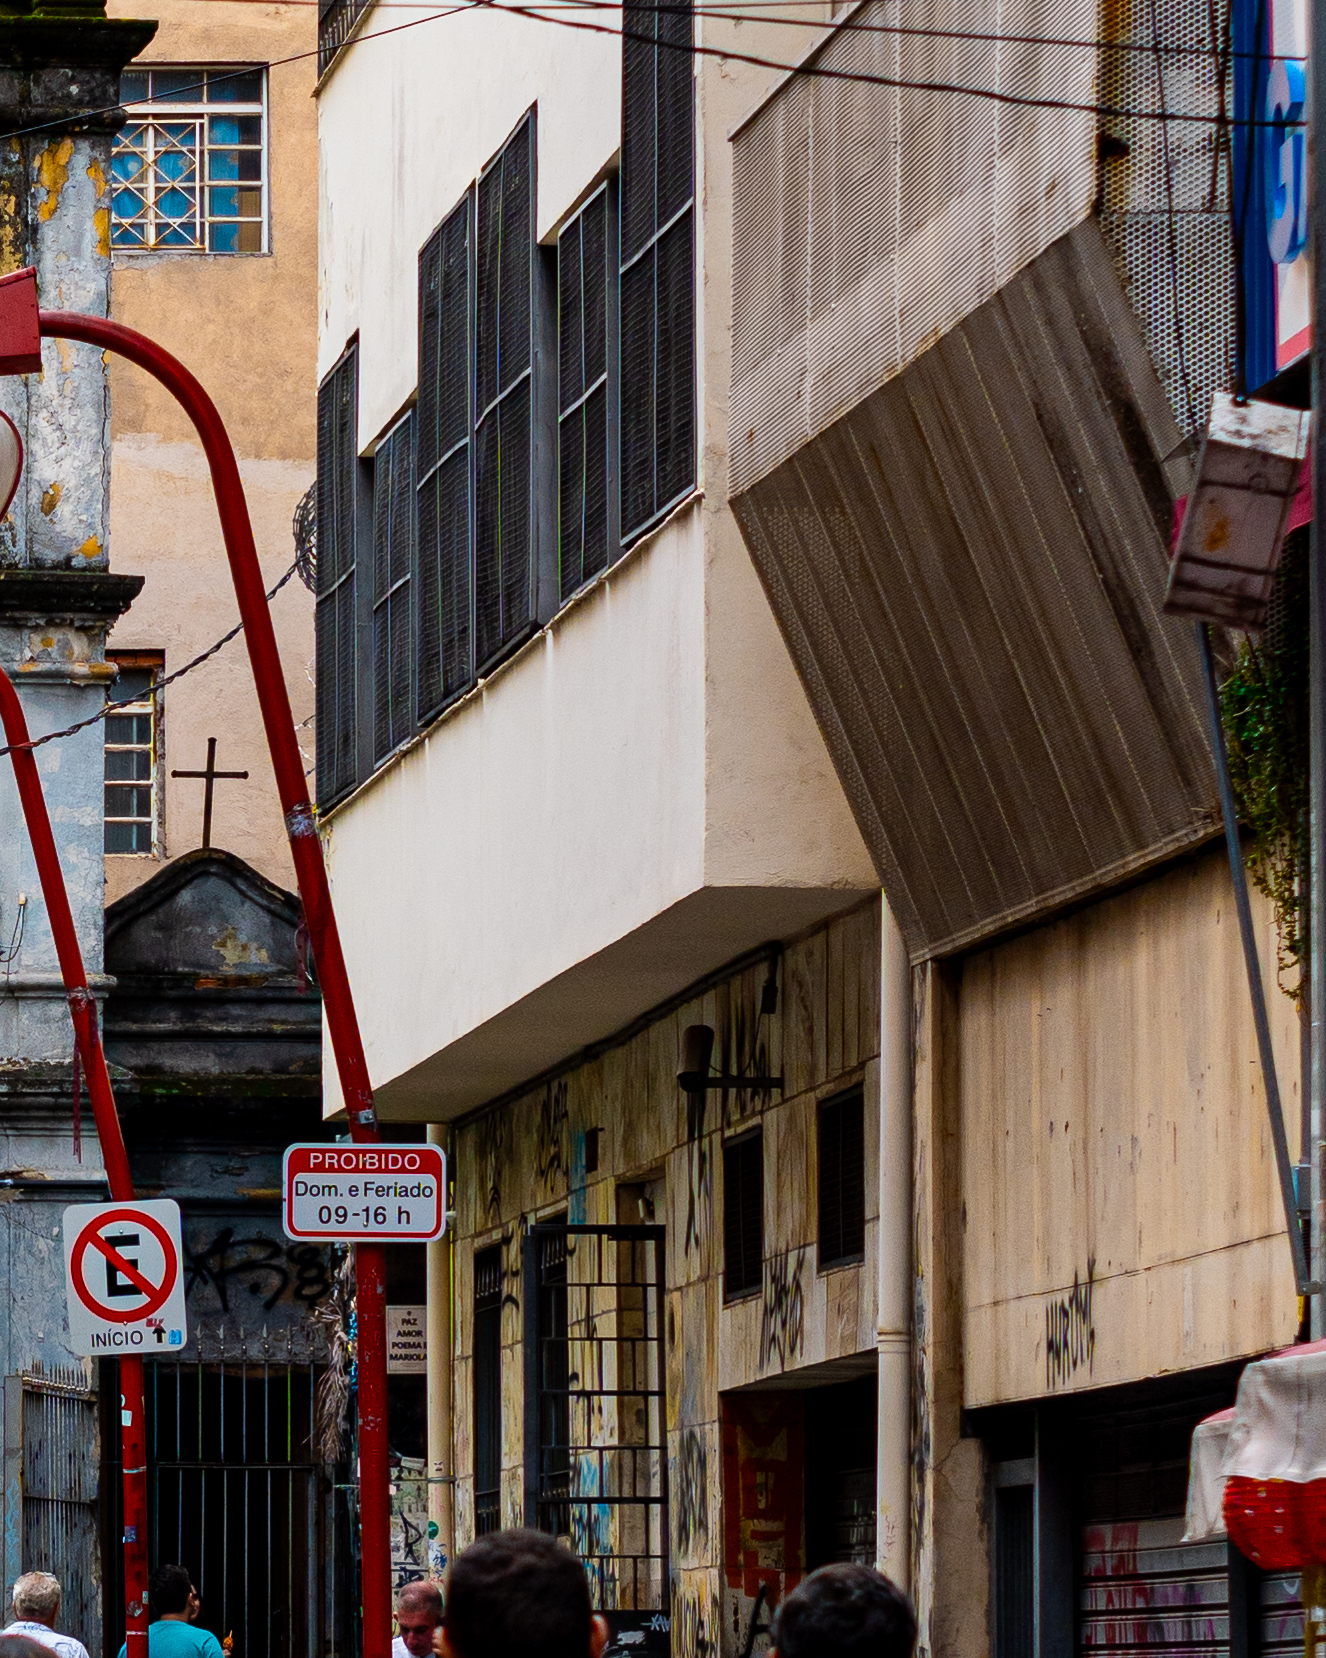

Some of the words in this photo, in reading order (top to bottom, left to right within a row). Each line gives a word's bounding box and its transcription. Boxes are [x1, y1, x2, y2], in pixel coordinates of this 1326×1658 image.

[309, 1152, 421, 1170] PROIBIDO
[294, 1180, 344, 1198] Dom.
[348, 1184, 360, 1198] e
[363, 1181, 434, 1198] Feriado
[318, 1205, 387, 1225] 09-16
[397, 1205, 411, 1225] h
[401, 1317, 418, 1326] PAZ
[90, 1328, 144, 1348] INÍCIO
[396, 1329, 424, 1338] AMOR
[391, 1341, 422, 1350] POEMA
